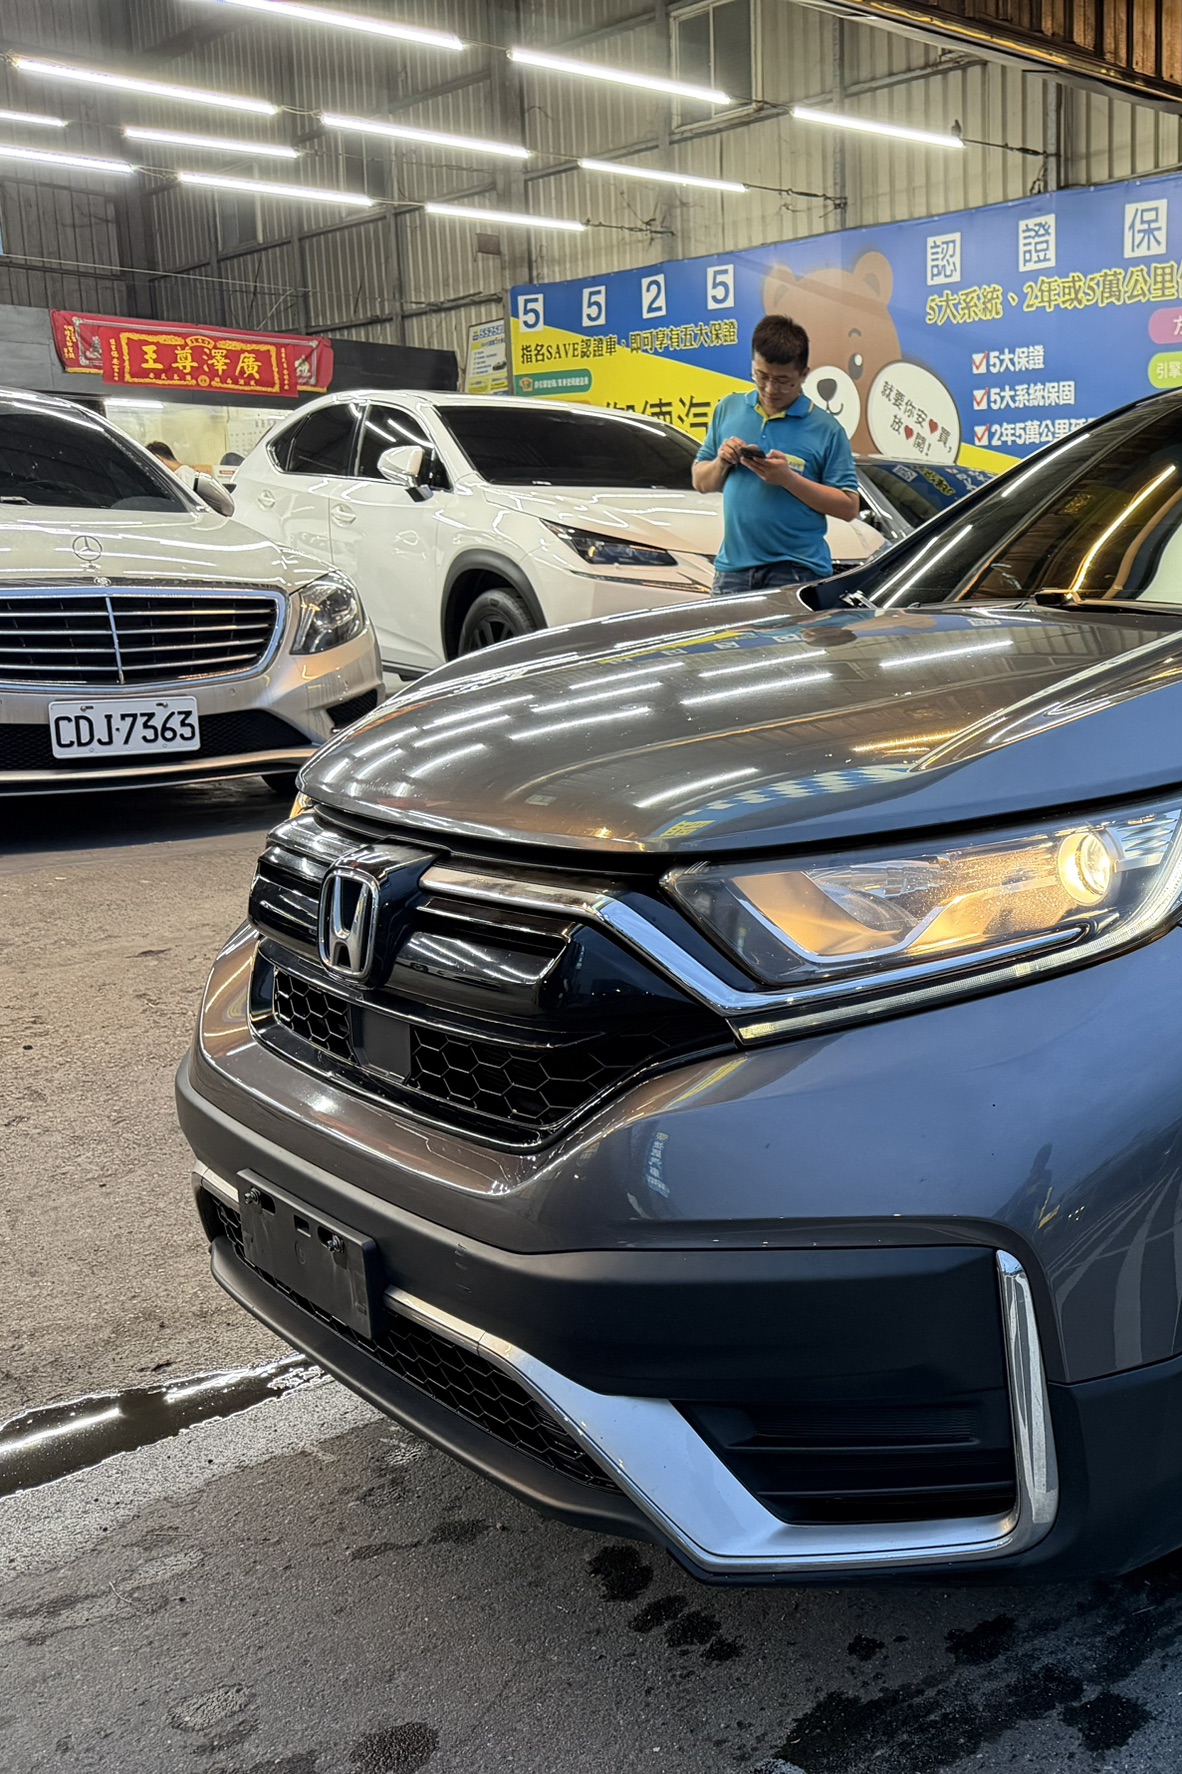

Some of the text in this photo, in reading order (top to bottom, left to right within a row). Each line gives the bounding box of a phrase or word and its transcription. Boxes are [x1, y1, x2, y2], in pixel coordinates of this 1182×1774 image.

[989, 345, 1045, 374] 5大保證
[990, 381, 1075, 411] 5大系統保固
